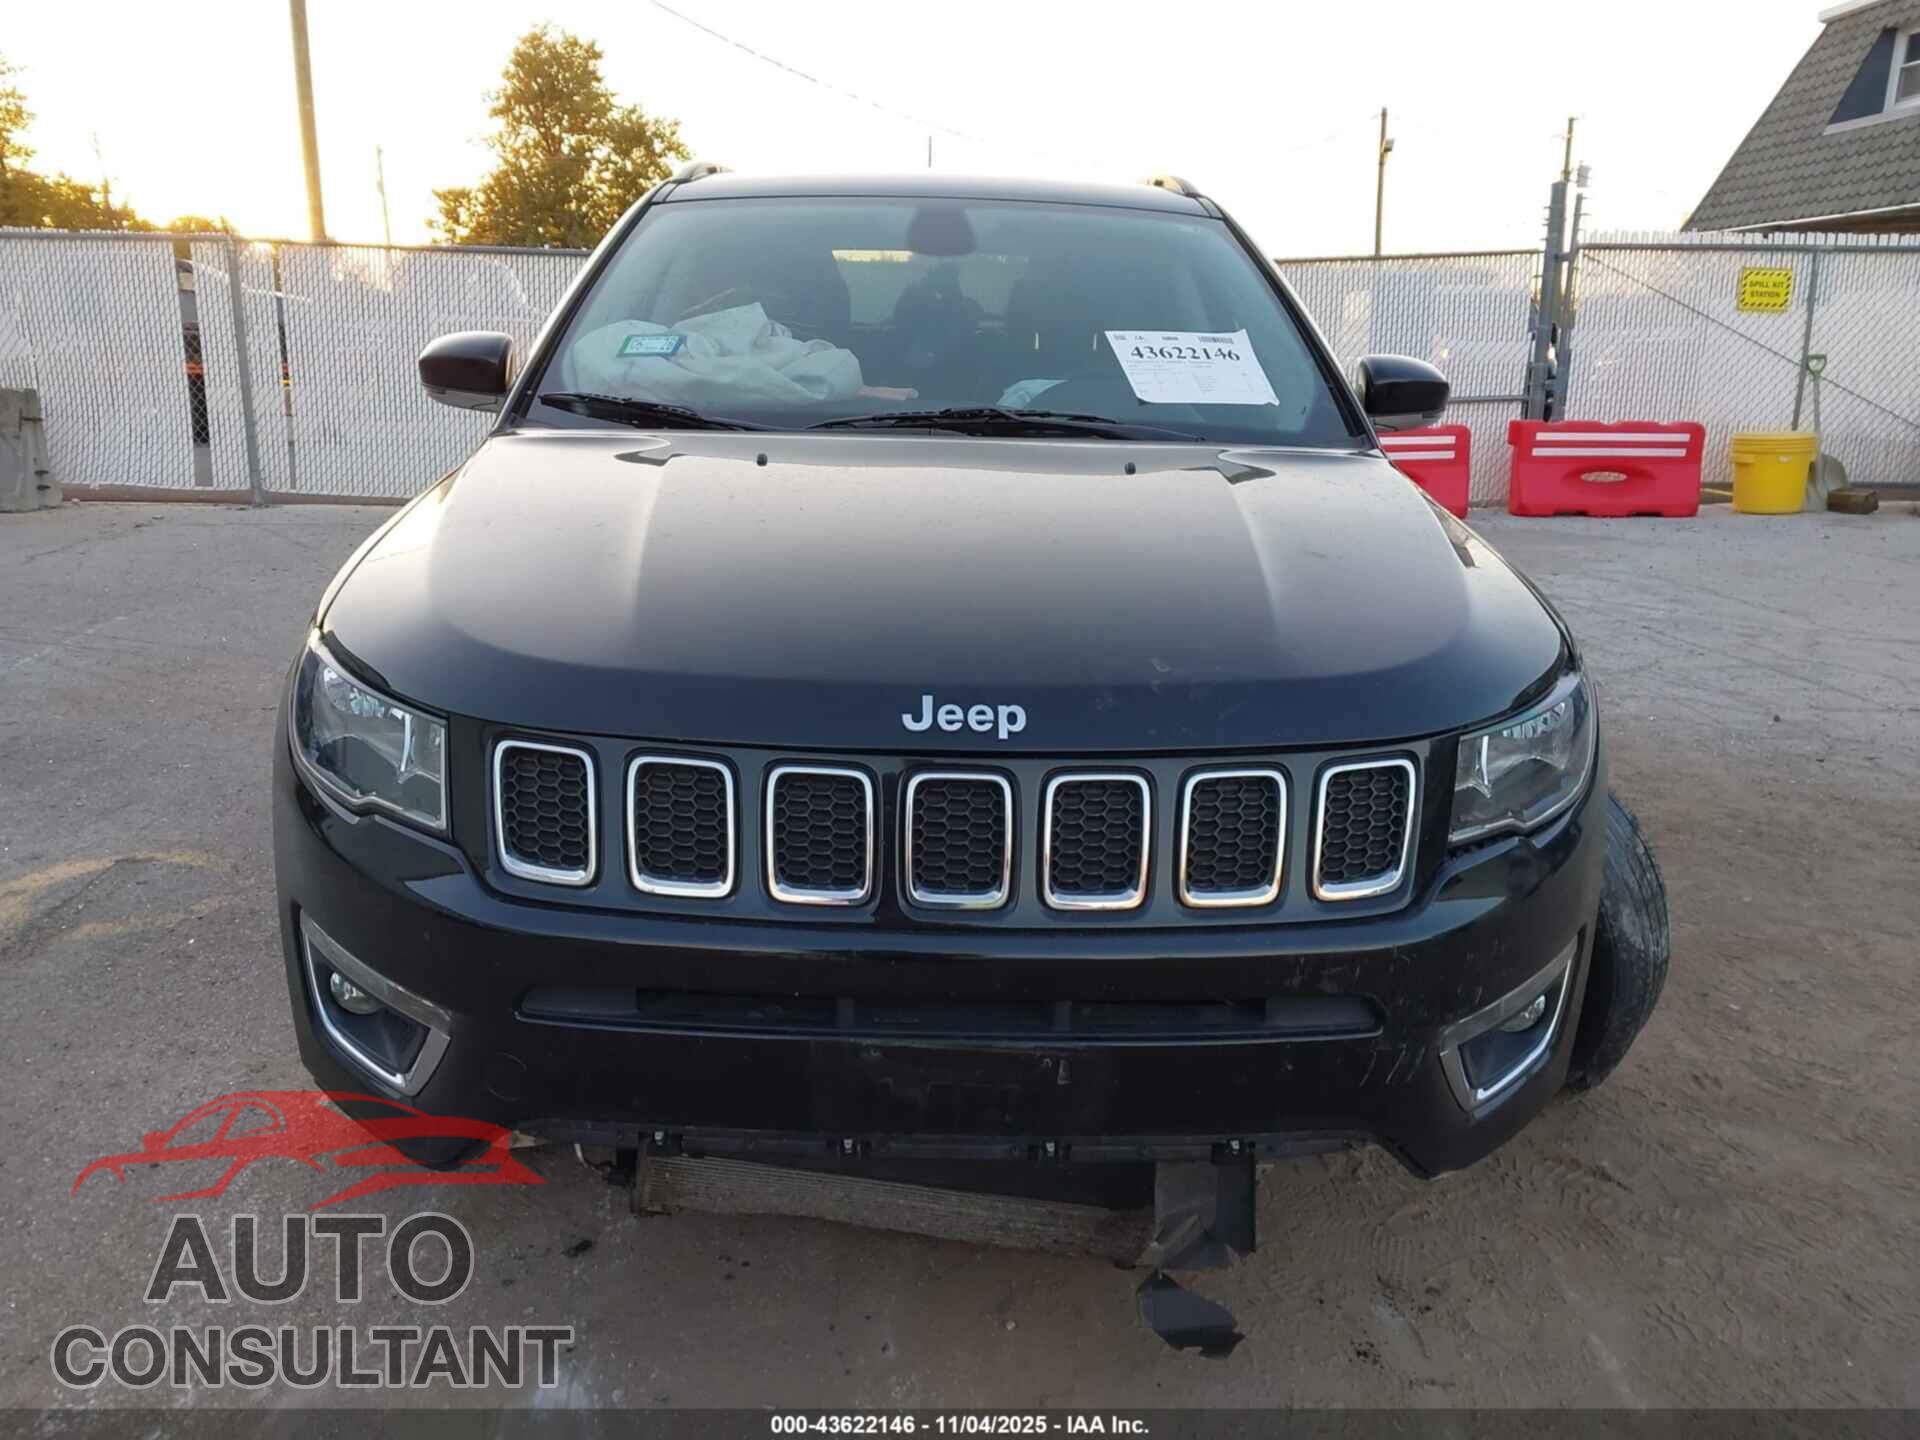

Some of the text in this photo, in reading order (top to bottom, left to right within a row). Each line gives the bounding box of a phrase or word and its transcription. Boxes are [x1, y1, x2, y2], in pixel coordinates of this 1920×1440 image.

[1748, 280, 1769, 288] SPILL
[1130, 345, 1241, 362] 43622146
[902, 695, 1027, 740] Jeep
